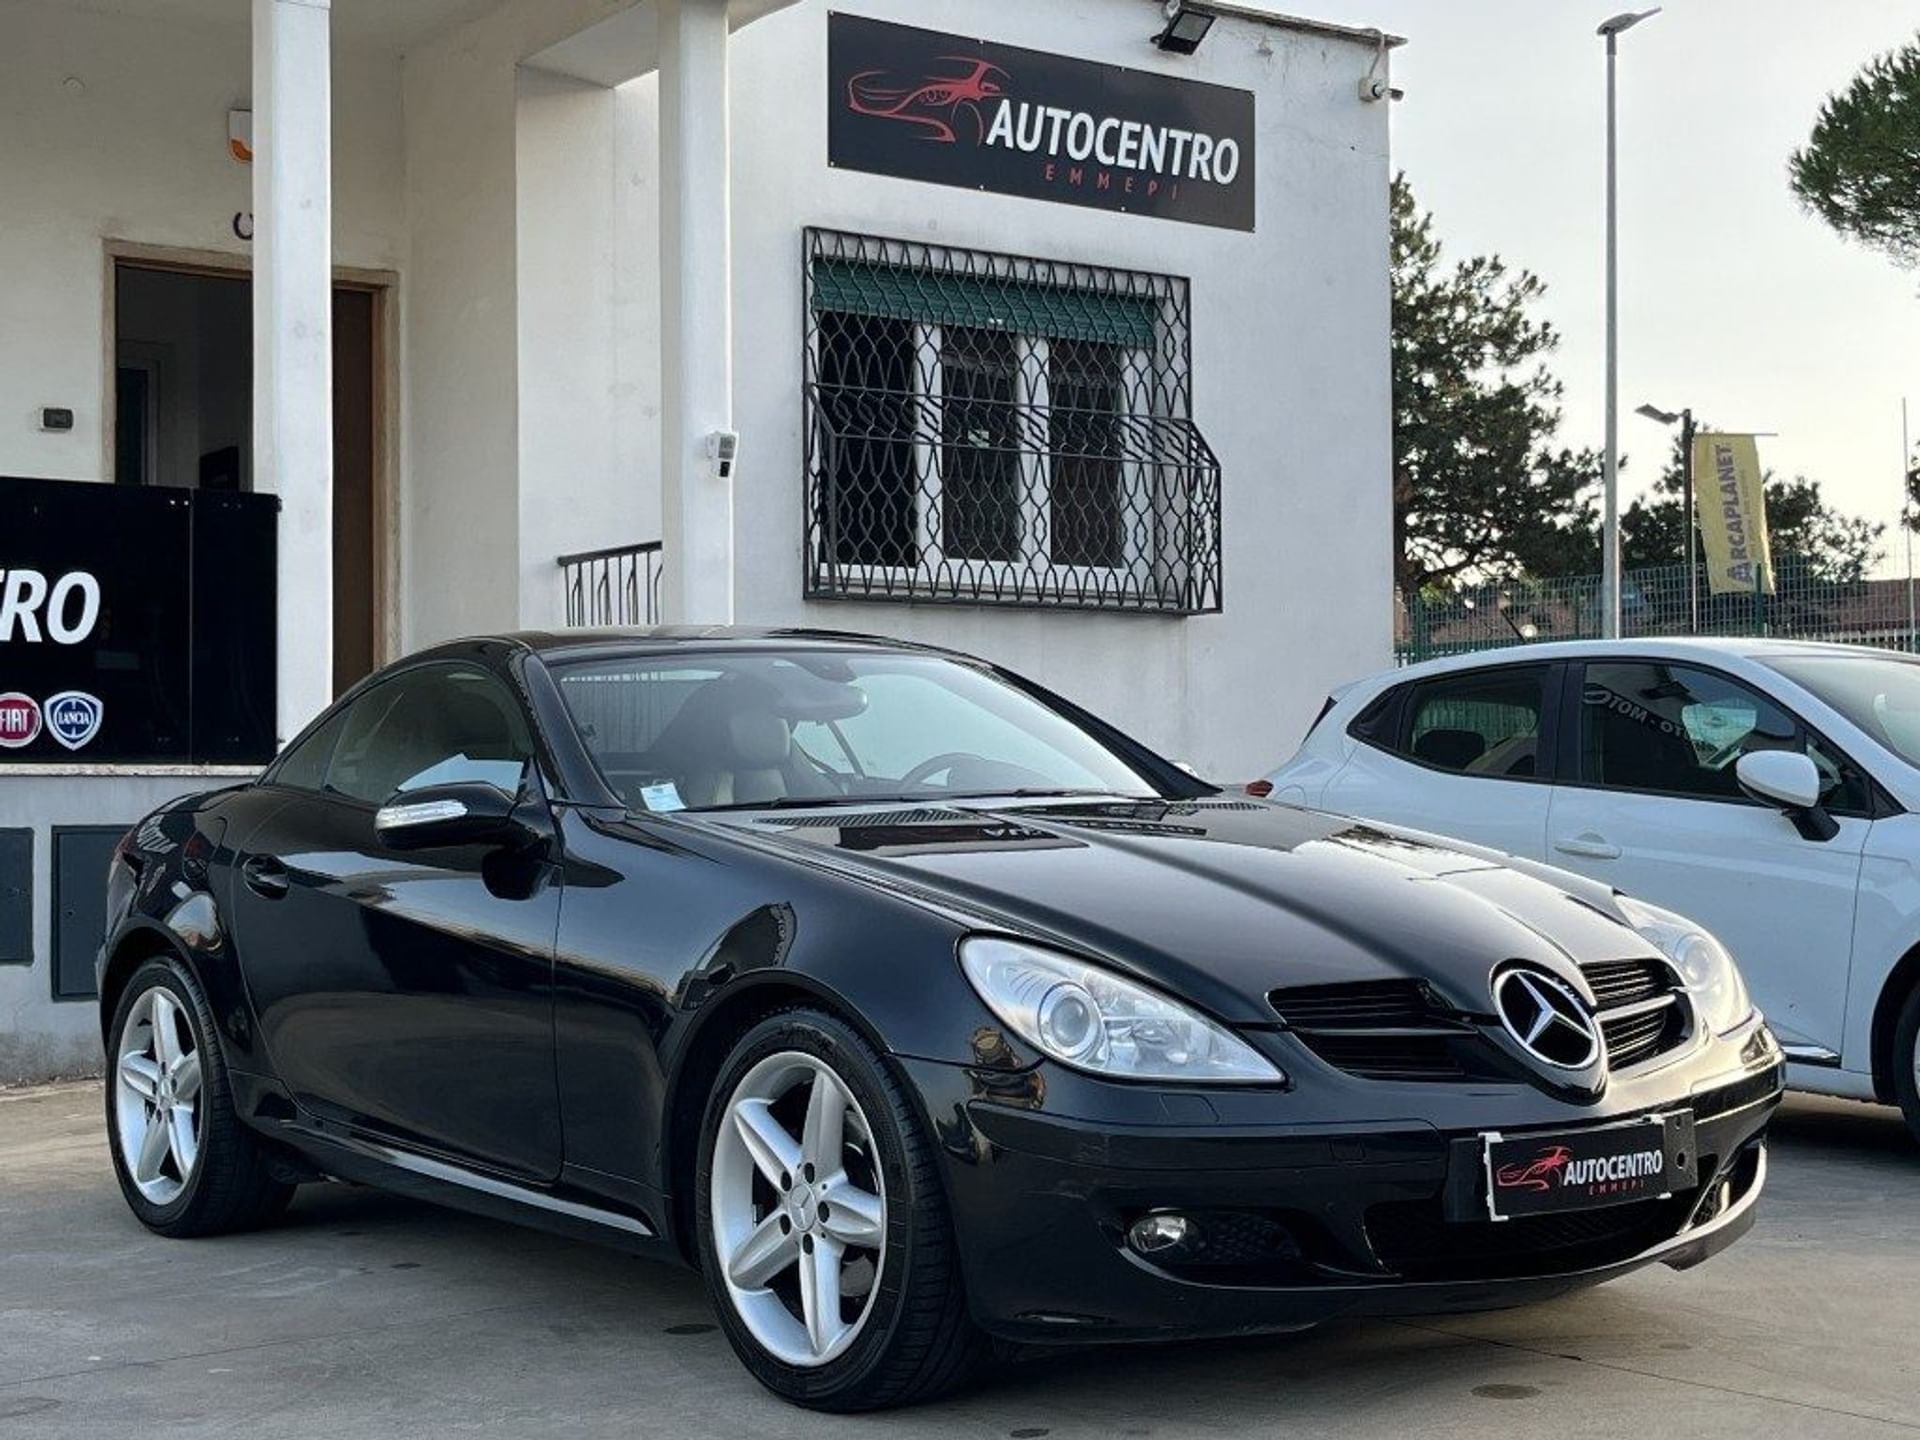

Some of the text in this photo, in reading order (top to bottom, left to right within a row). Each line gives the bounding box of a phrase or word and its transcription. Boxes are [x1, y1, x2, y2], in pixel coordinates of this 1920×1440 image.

[986, 99, 1240, 185] AUTOCENTRO
[1043, 164, 1178, 200] EMMEPI
[1714, 444, 1754, 584] ARCAPLANET
[0, 569, 101, 645] RO
[58, 711, 90, 725] LANCIA
[1563, 1149, 1663, 1186] AUTOCENTRO
[1588, 1179, 1645, 1195] EMMEPI
